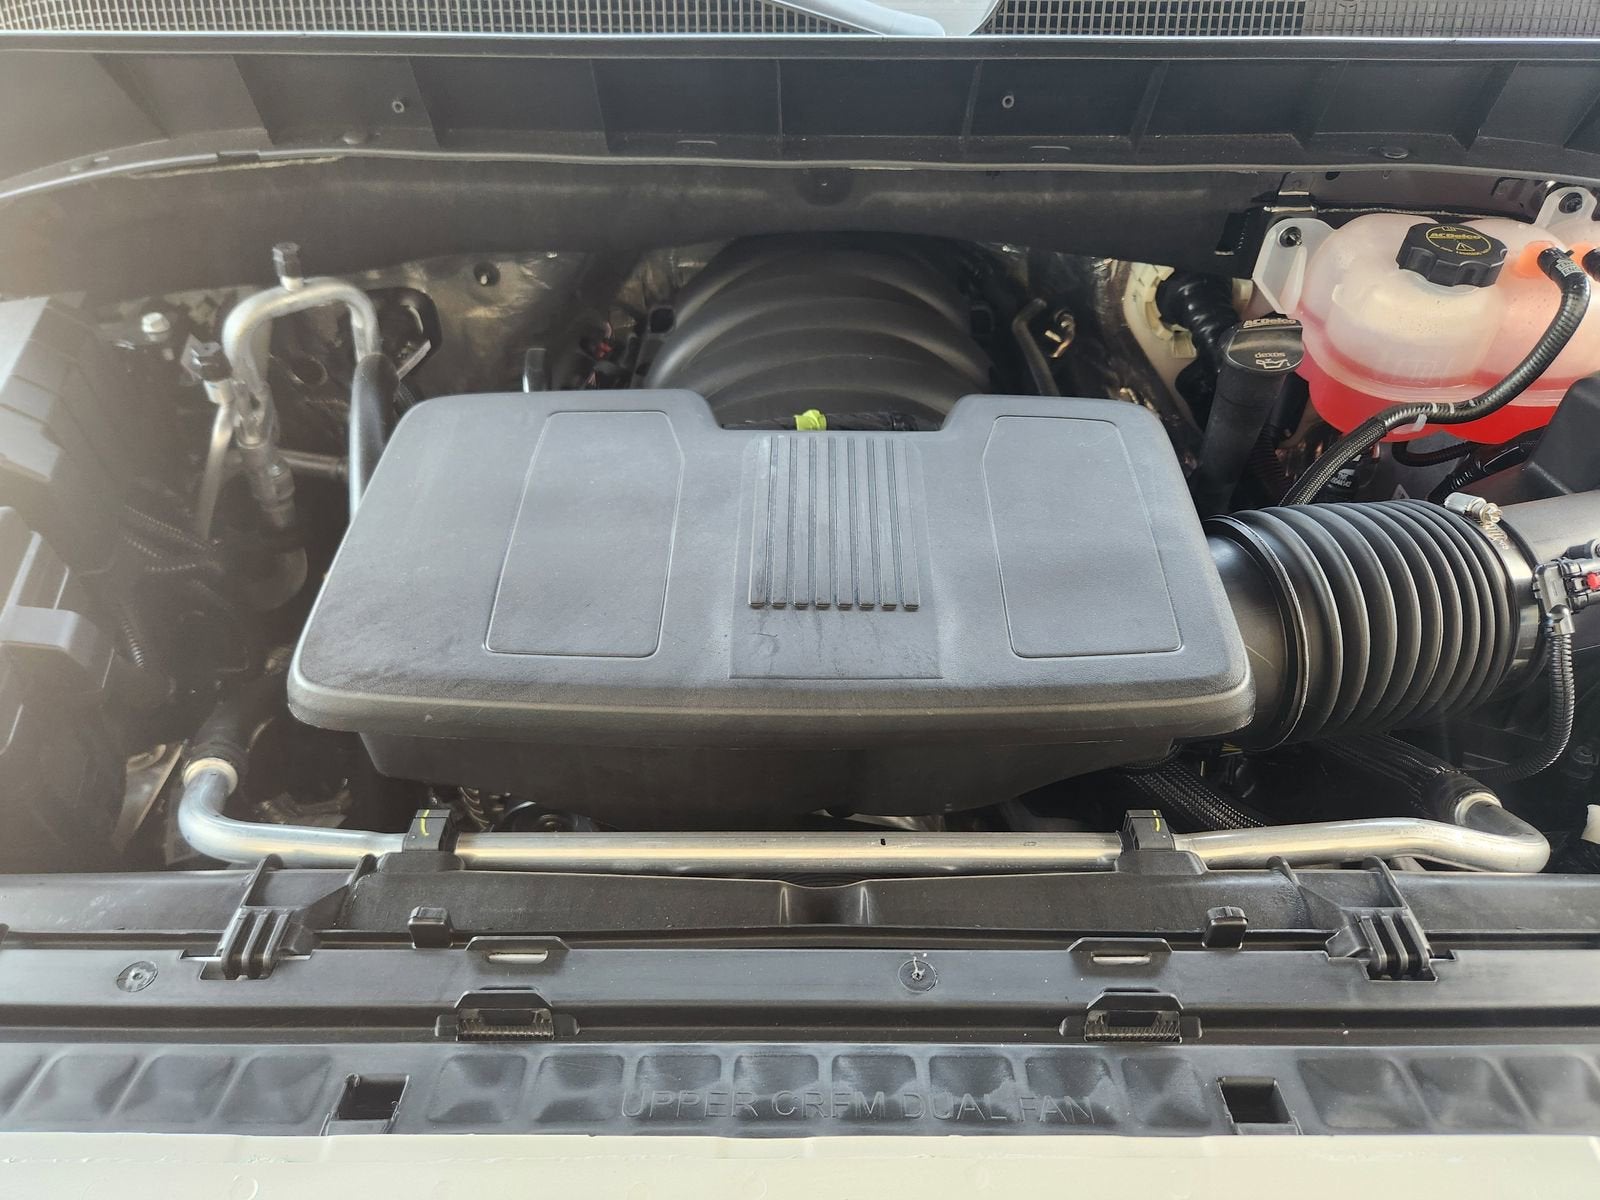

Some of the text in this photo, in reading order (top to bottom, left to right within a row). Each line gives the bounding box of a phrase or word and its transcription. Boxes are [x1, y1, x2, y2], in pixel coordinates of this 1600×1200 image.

[1428, 232, 1482, 240] ACDelco
[1242, 317, 1297, 329] ACDelco
[621, 1089, 761, 1118] UPPER
[902, 1092, 1008, 1121] DUAL
[1018, 1095, 1095, 1124] FAN
